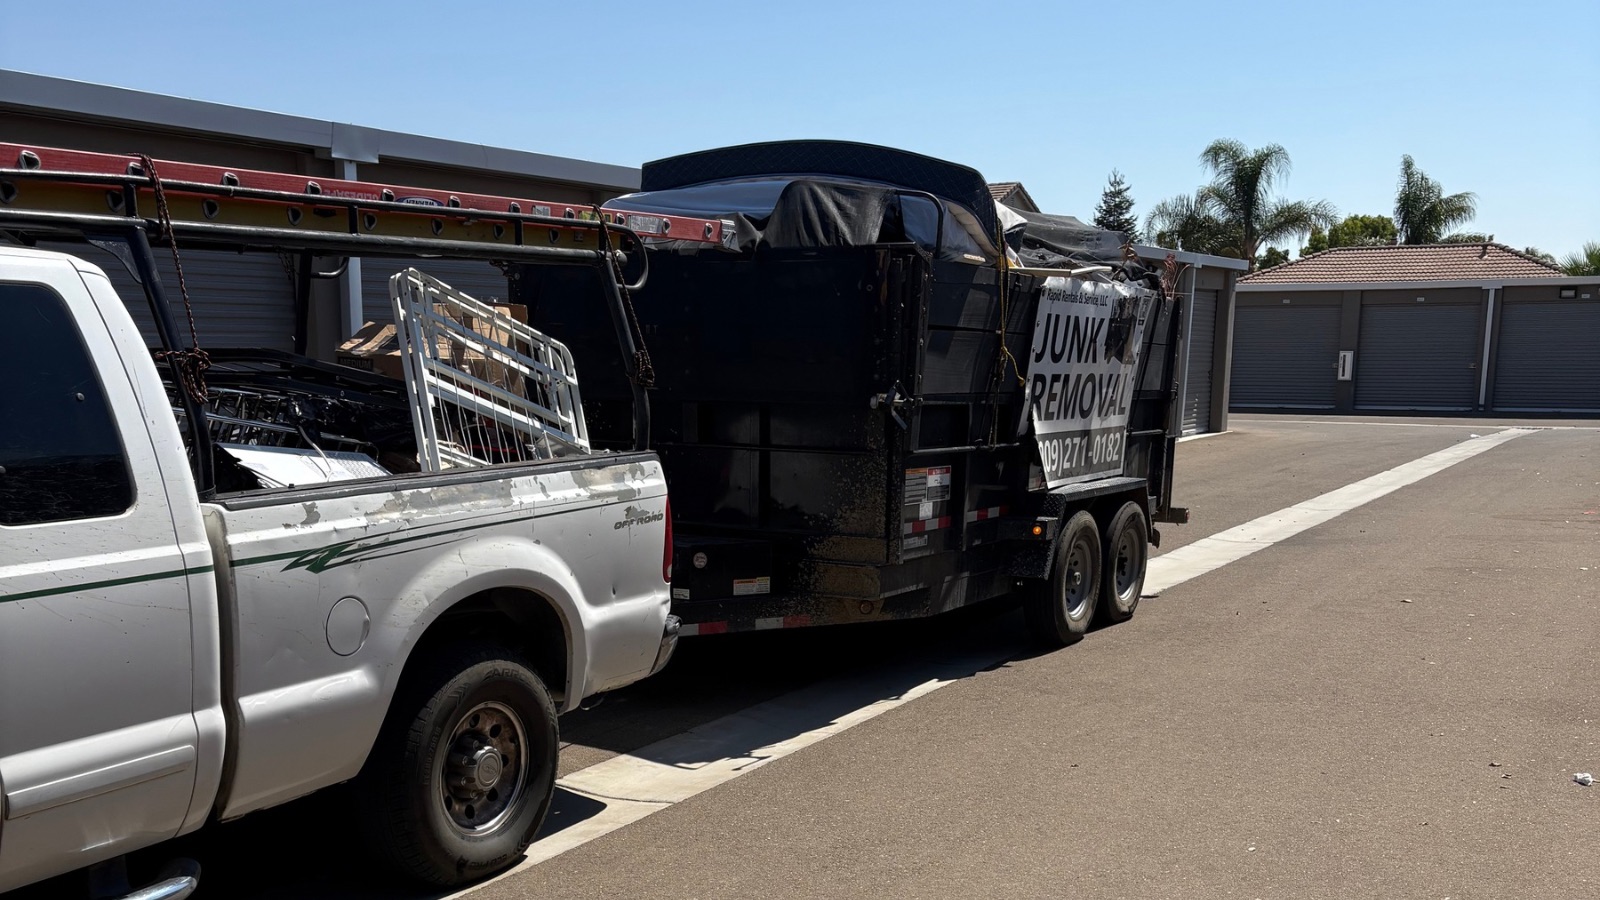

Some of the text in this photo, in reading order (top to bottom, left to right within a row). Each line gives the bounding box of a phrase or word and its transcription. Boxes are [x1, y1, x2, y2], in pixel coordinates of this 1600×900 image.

[1046, 288, 1109, 307] Rapid Rentals & Service, LLC
[1035, 313, 1105, 364] JUNK
[340, 358, 371, 370] MEDIUM
[1029, 373, 1128, 422] REMOVAL
